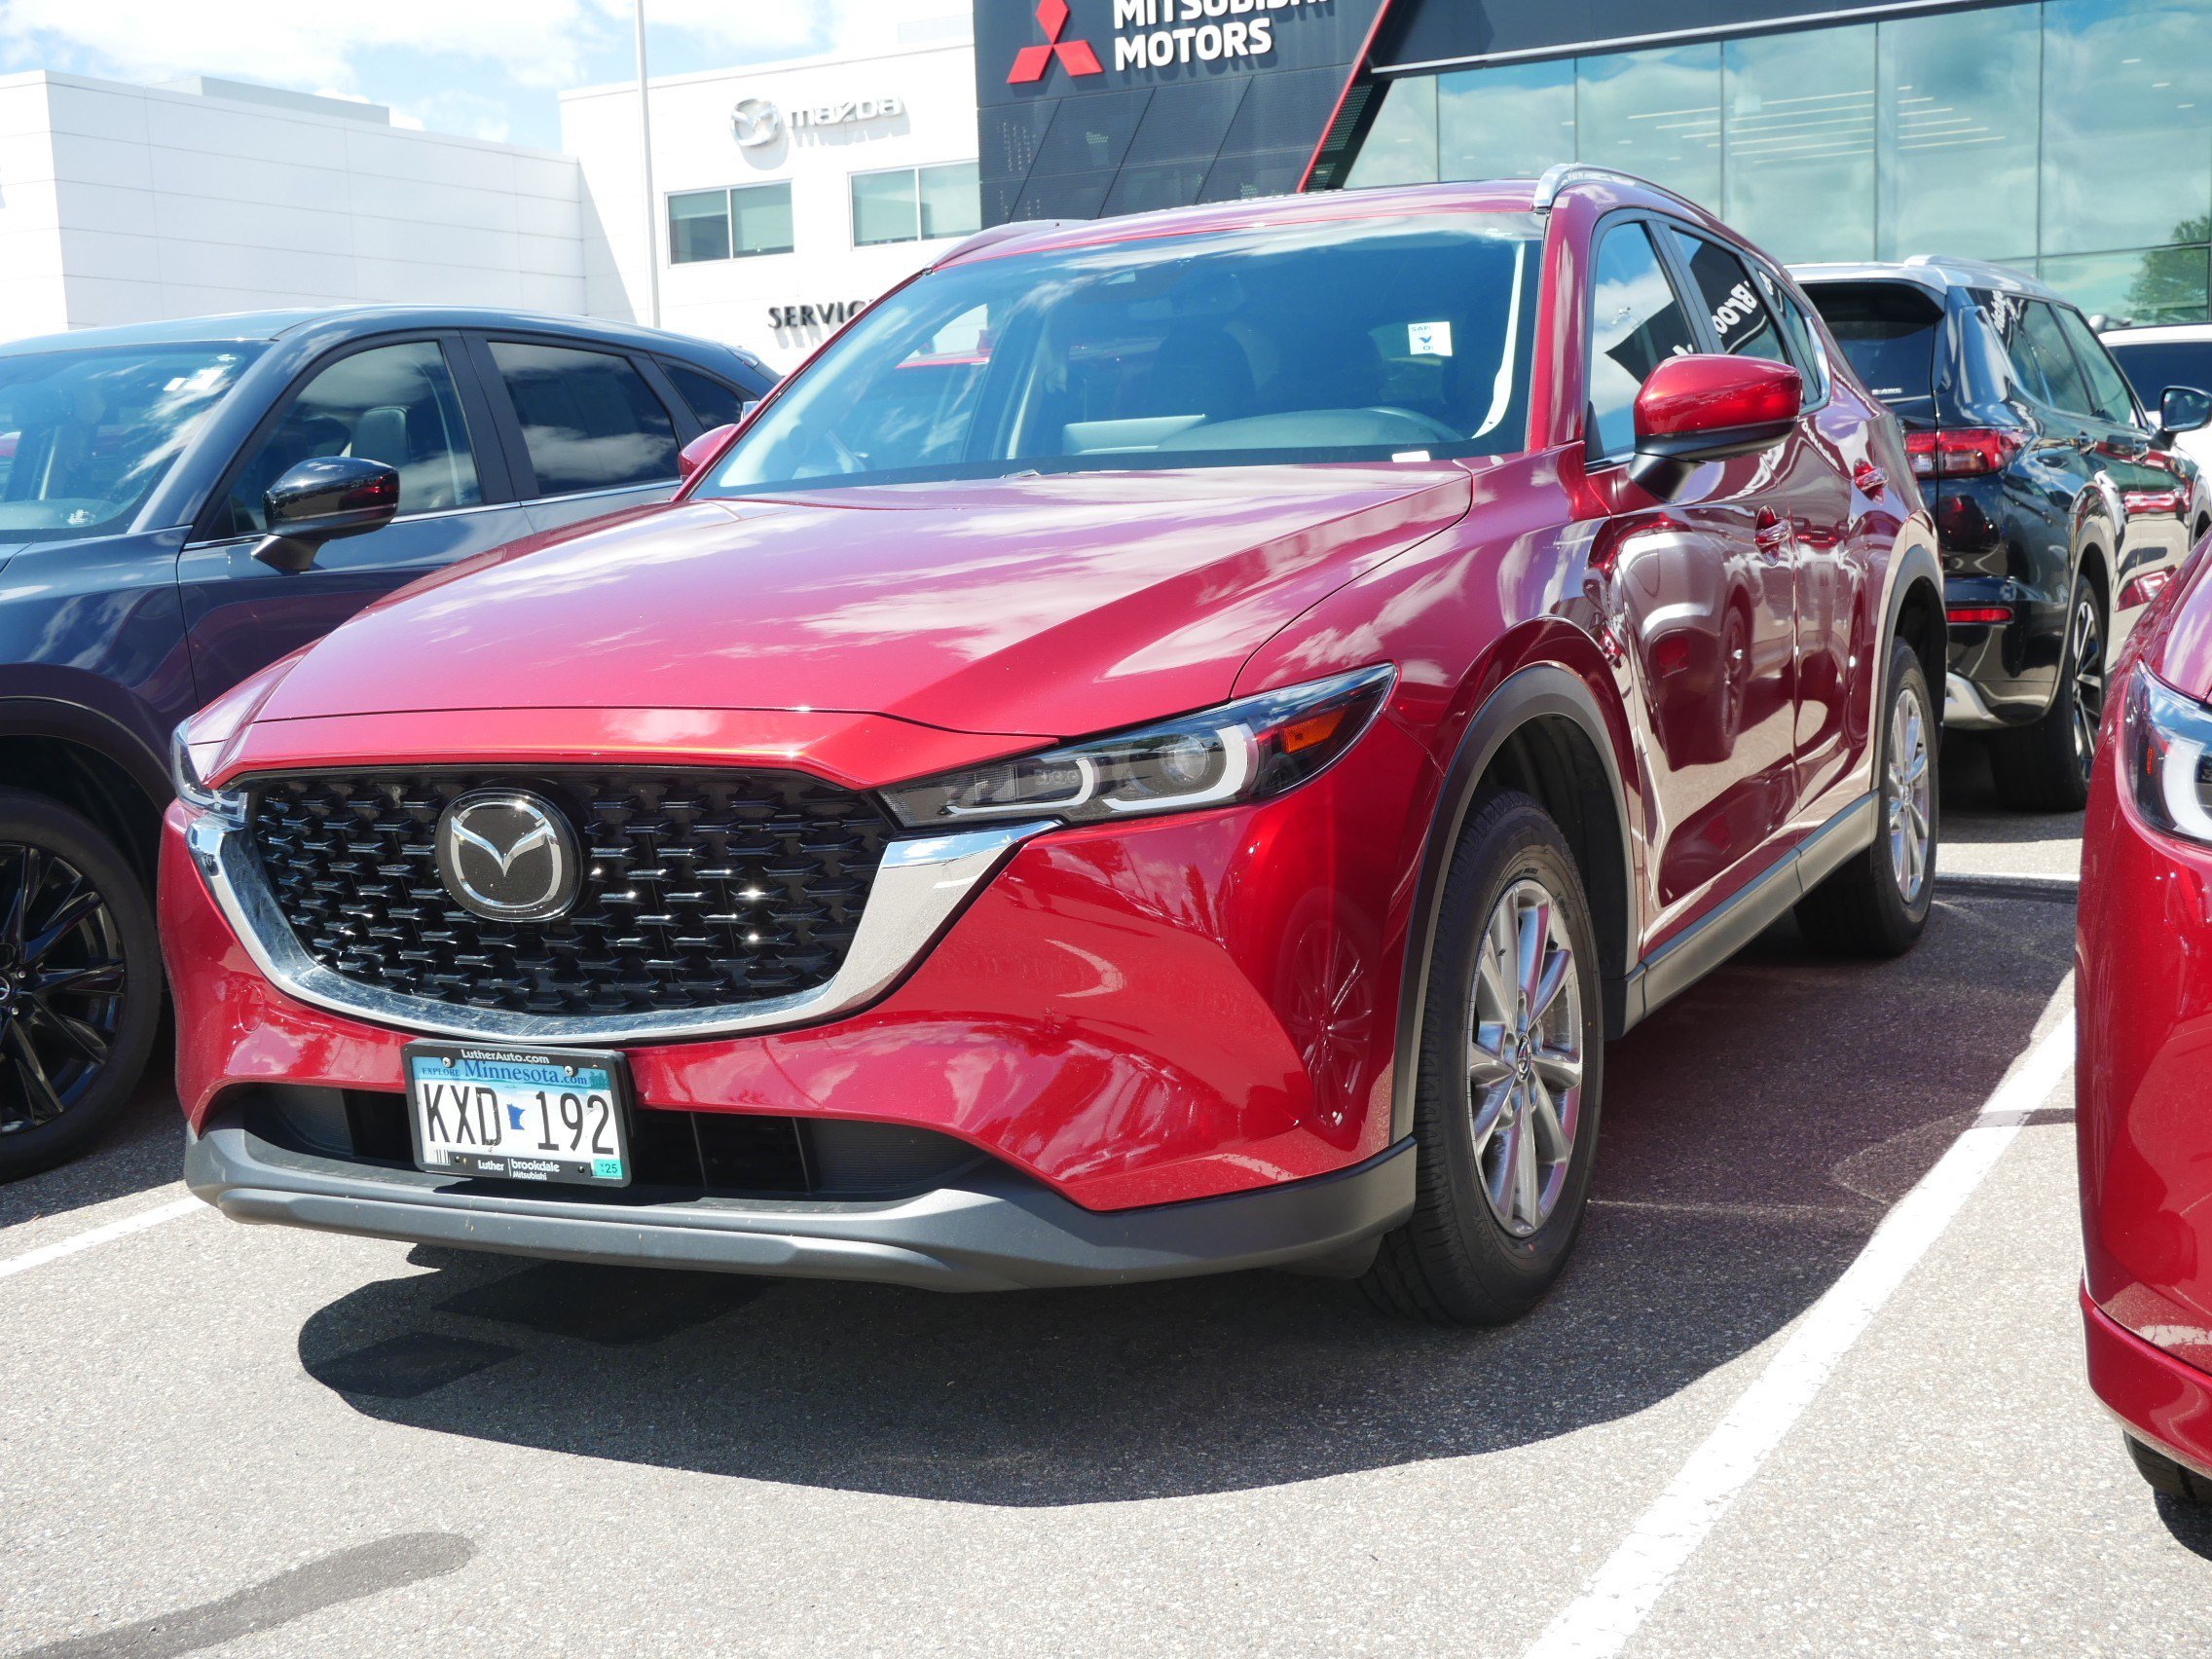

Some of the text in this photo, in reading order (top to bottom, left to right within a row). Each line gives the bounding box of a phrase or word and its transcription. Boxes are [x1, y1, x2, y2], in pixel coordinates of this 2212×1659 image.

[1113, 0, 1328, 29] MITSU
[1115, 18, 1272, 71] MOTORS
[787, 97, 903, 129] mazda
[768, 299, 874, 329] SERVIC
[461, 1050, 550, 1064] LutherAuto.com
[422, 1067, 461, 1077] EXPLORE
[424, 1083, 614, 1156] KXD 192
[478, 1159, 560, 1173] Luther brookdale
[512, 1170, 547, 1181] Mitsubishi
[605, 1163, 618, 1174] 25
